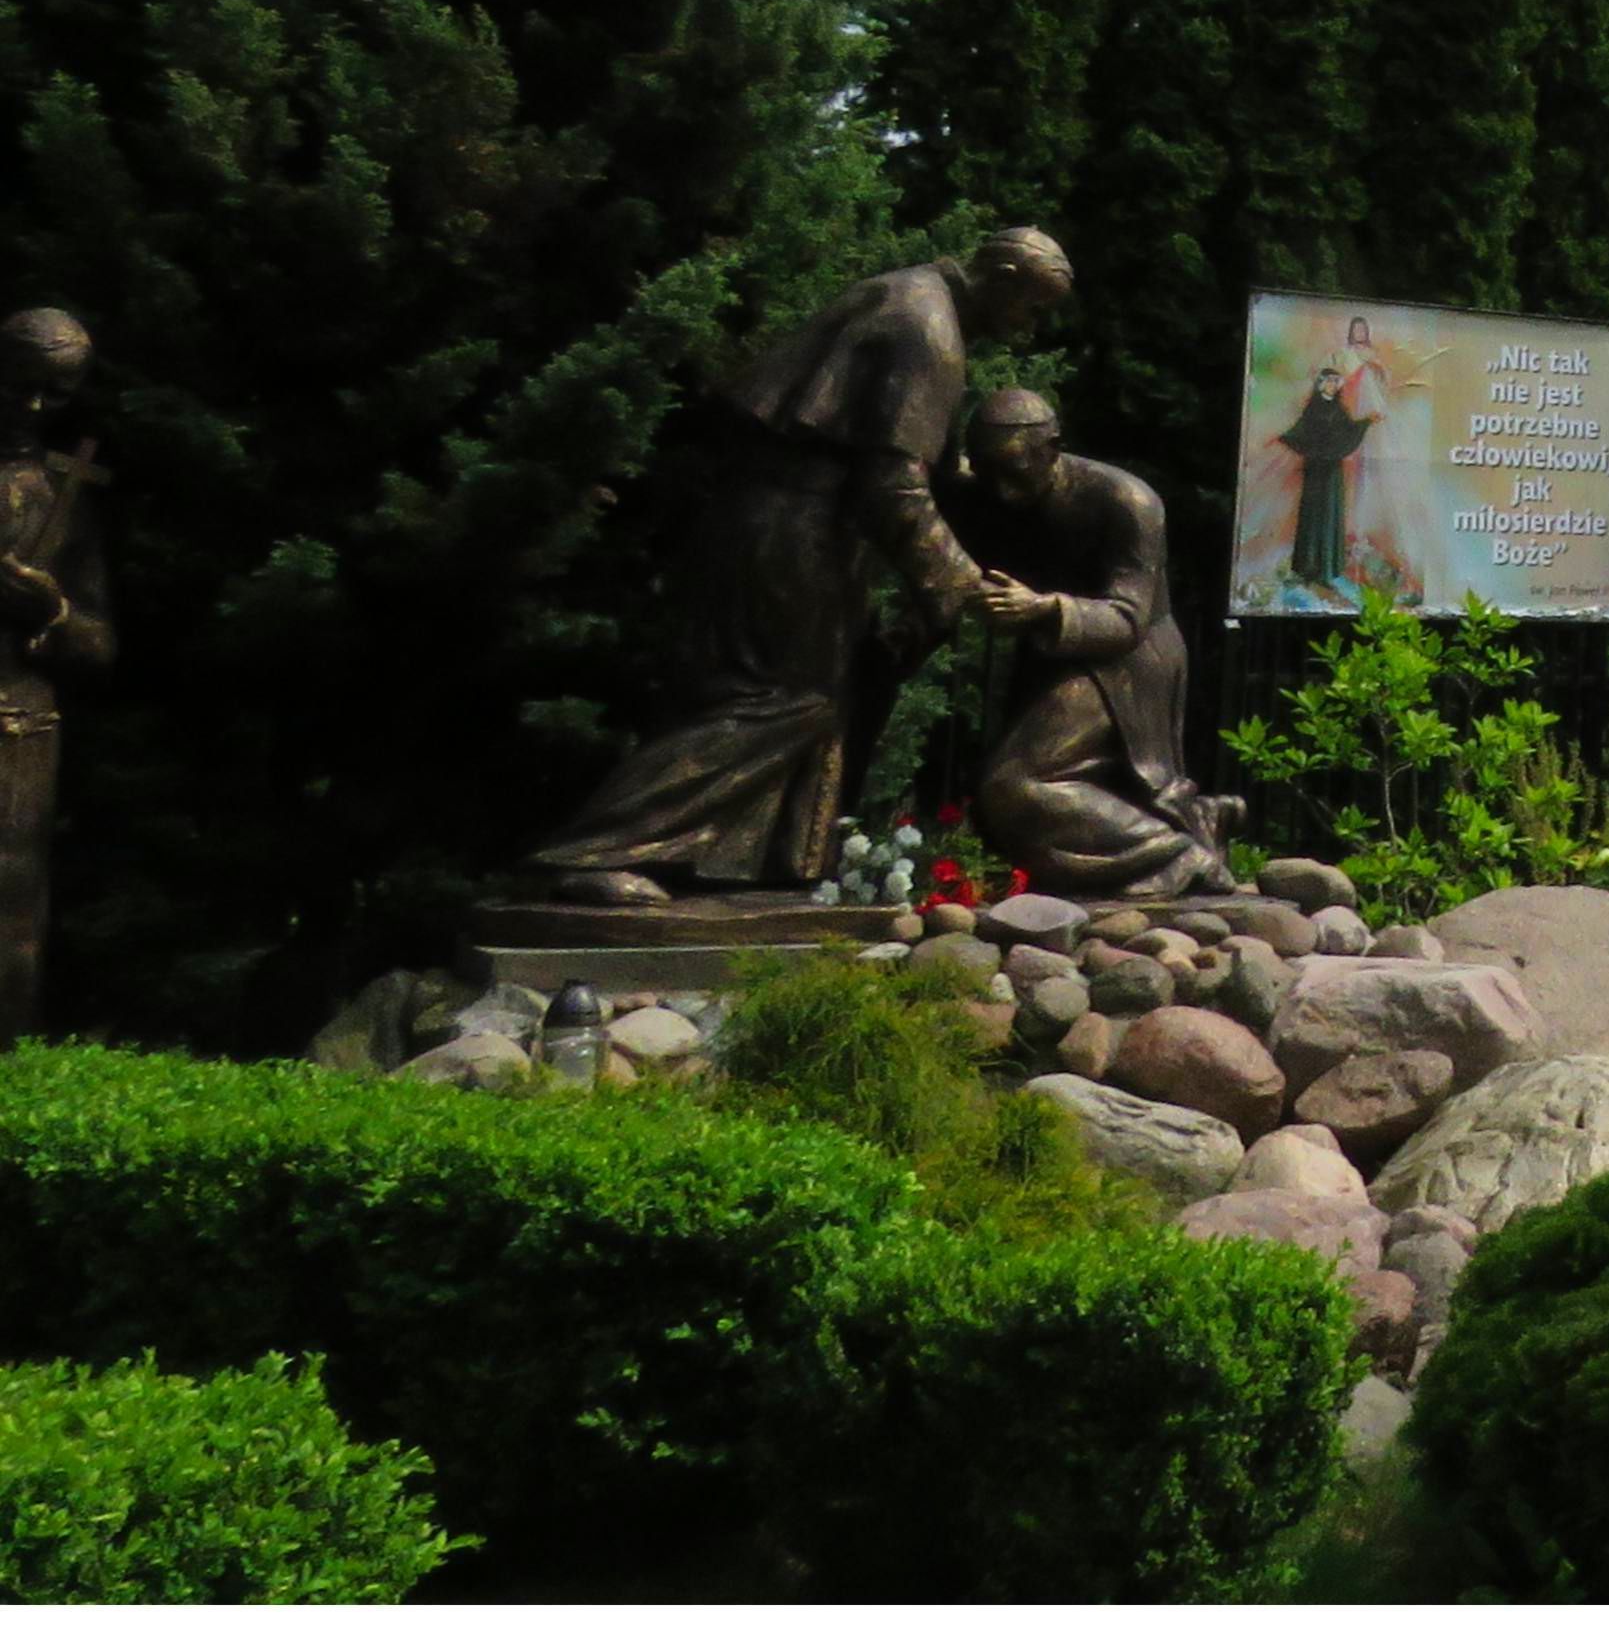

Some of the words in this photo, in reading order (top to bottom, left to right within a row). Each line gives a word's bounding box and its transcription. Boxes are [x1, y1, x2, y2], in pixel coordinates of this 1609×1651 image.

[1487, 346, 1541, 373] „Nic
[1549, 349, 1590, 375] tak
[1491, 378, 1530, 404] nie
[1537, 378, 1583, 411] jest
[1470, 412, 1600, 440] potrzebne
[1511, 474, 1552, 507] jak
[1453, 504, 1607, 535] miłosierdzie
